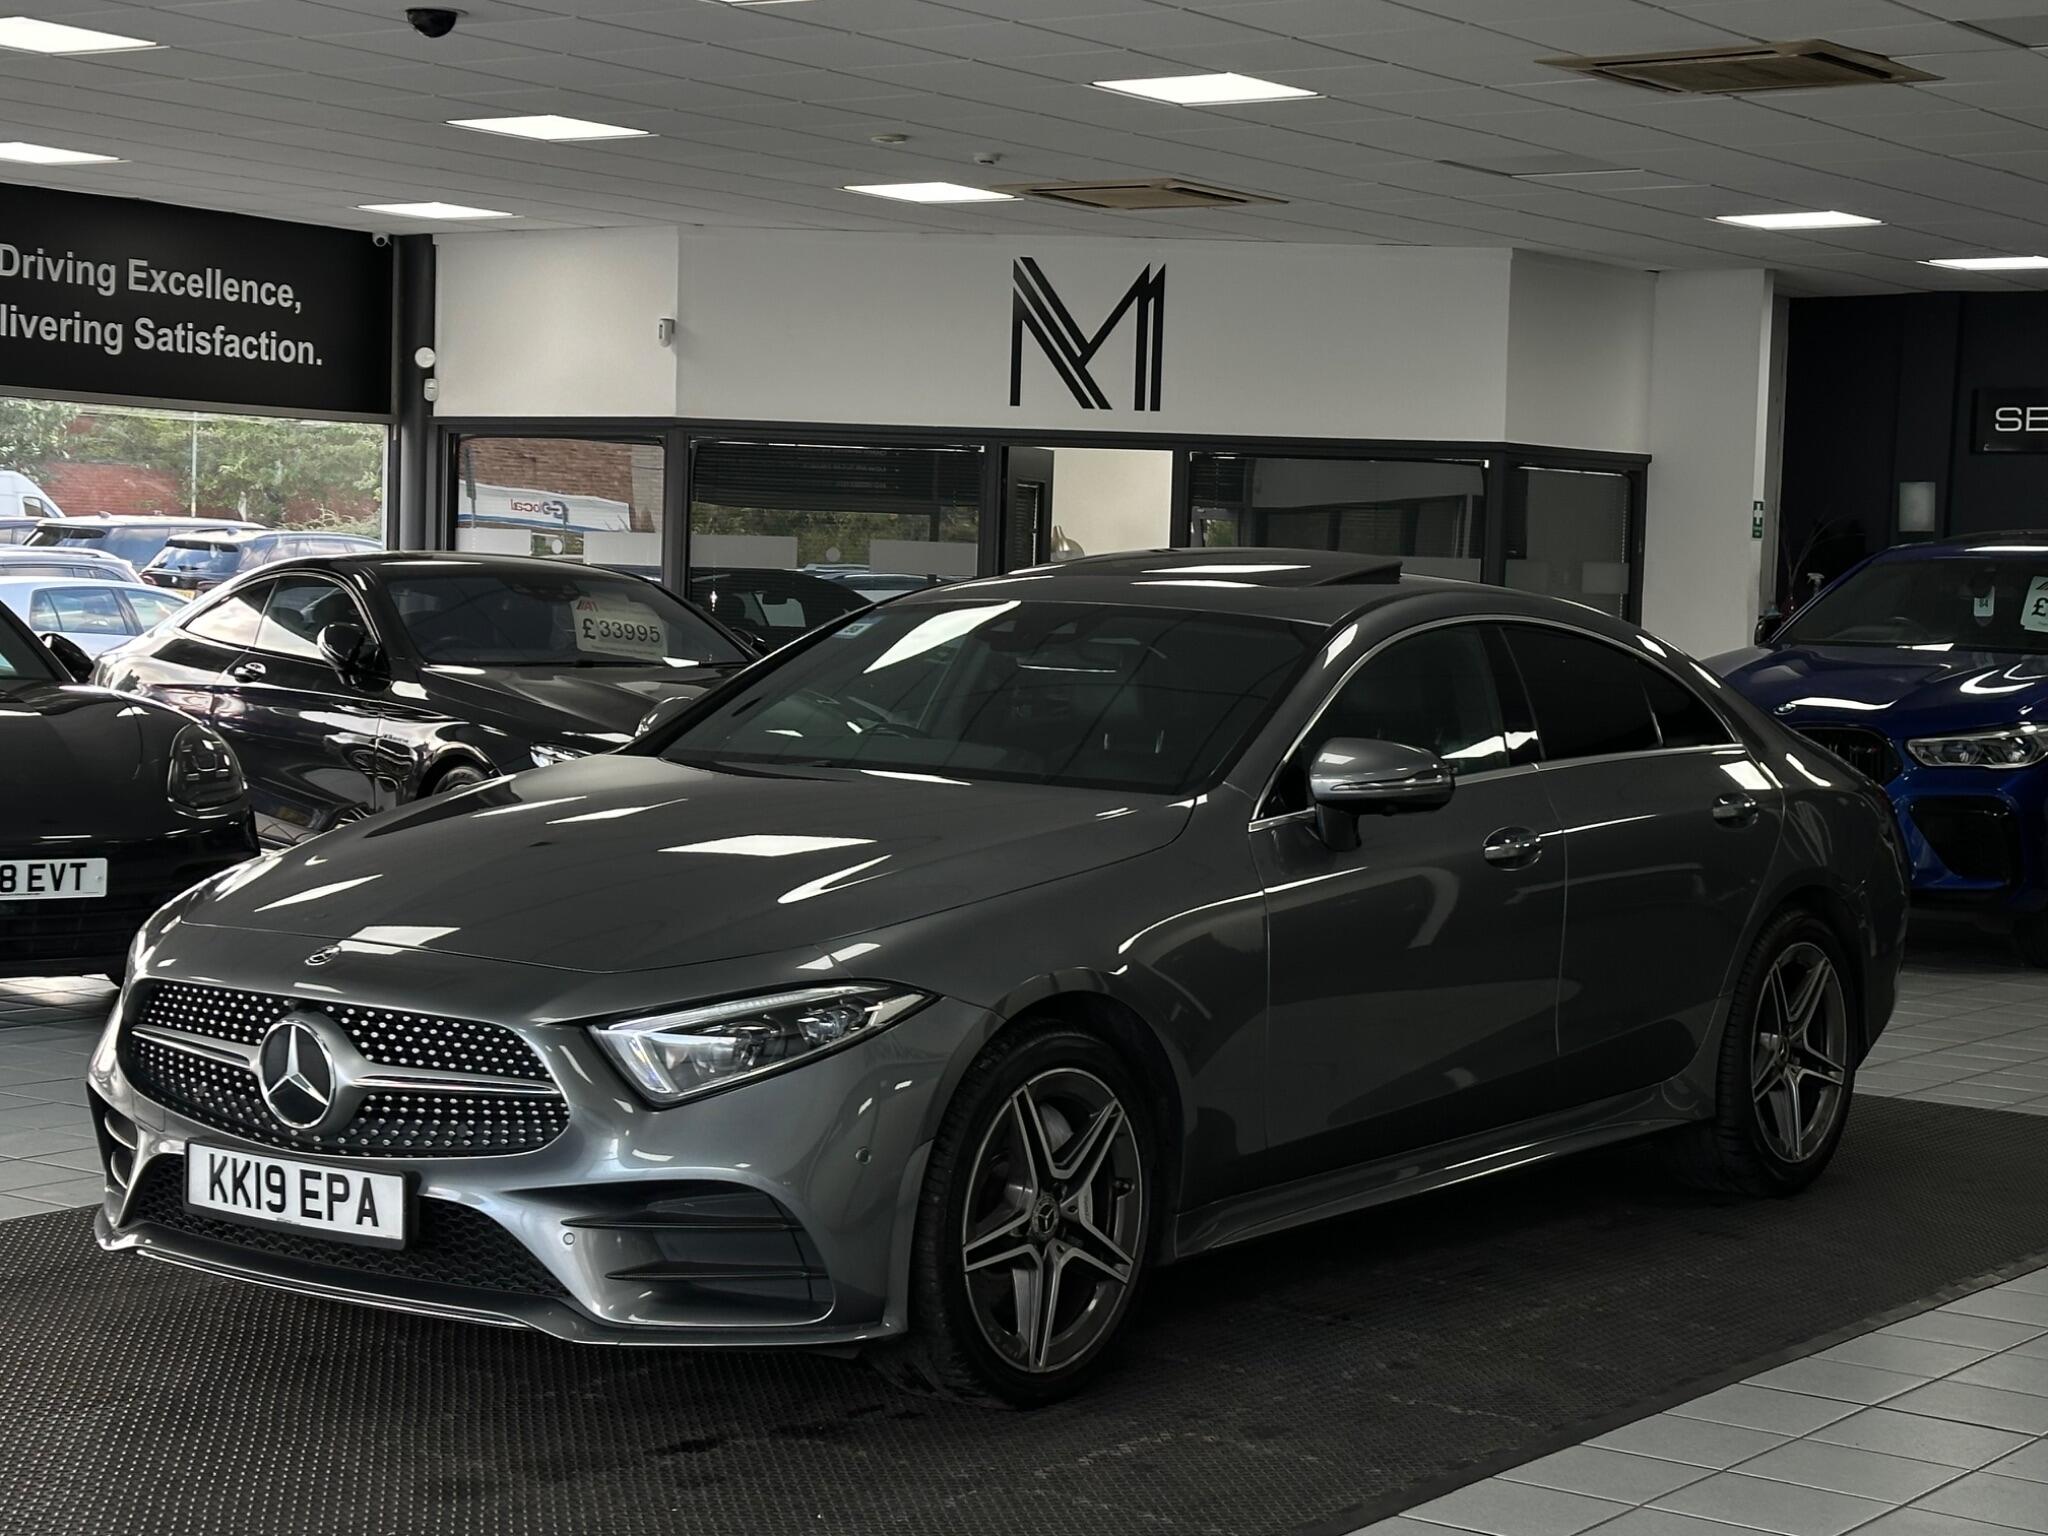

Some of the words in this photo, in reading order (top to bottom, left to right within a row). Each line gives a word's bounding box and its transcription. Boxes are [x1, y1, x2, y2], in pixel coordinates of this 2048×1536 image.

[0, 243, 116, 296] Driving
[128, 258, 302, 314] Excellence,
[0, 303, 123, 355] livering
[134, 317, 322, 365] Satisfaction.
[27, 862, 87, 893] EVT
[209, 1153, 286, 1213] KK19
[299, 1168, 379, 1227] EPA
